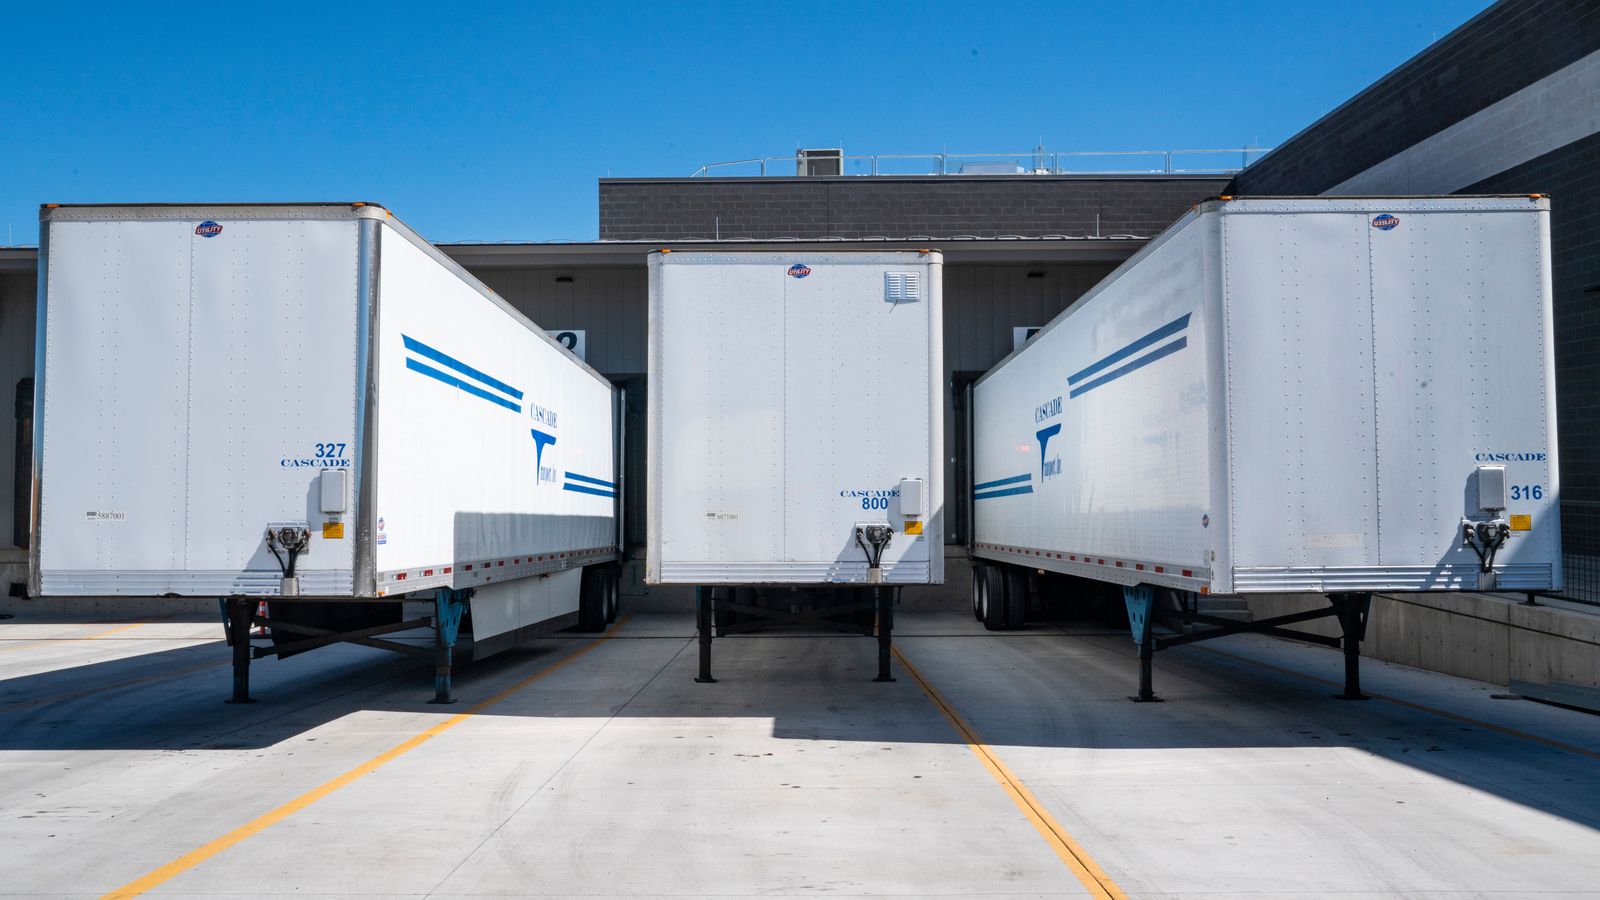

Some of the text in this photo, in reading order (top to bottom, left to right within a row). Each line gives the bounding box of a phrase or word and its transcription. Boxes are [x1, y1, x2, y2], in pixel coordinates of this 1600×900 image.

[1373, 217, 1399, 226] UTILITY
[196, 225, 222, 234] UTILITY
[530, 402, 558, 428] CASCADE
[1035, 396, 1063, 424] CASCADE
[315, 443, 346, 458] 327
[1475, 453, 1546, 461] CASCADE
[281, 459, 350, 467] CASCADE
[1511, 485, 1543, 500] 316
[862, 497, 889, 510] 800
